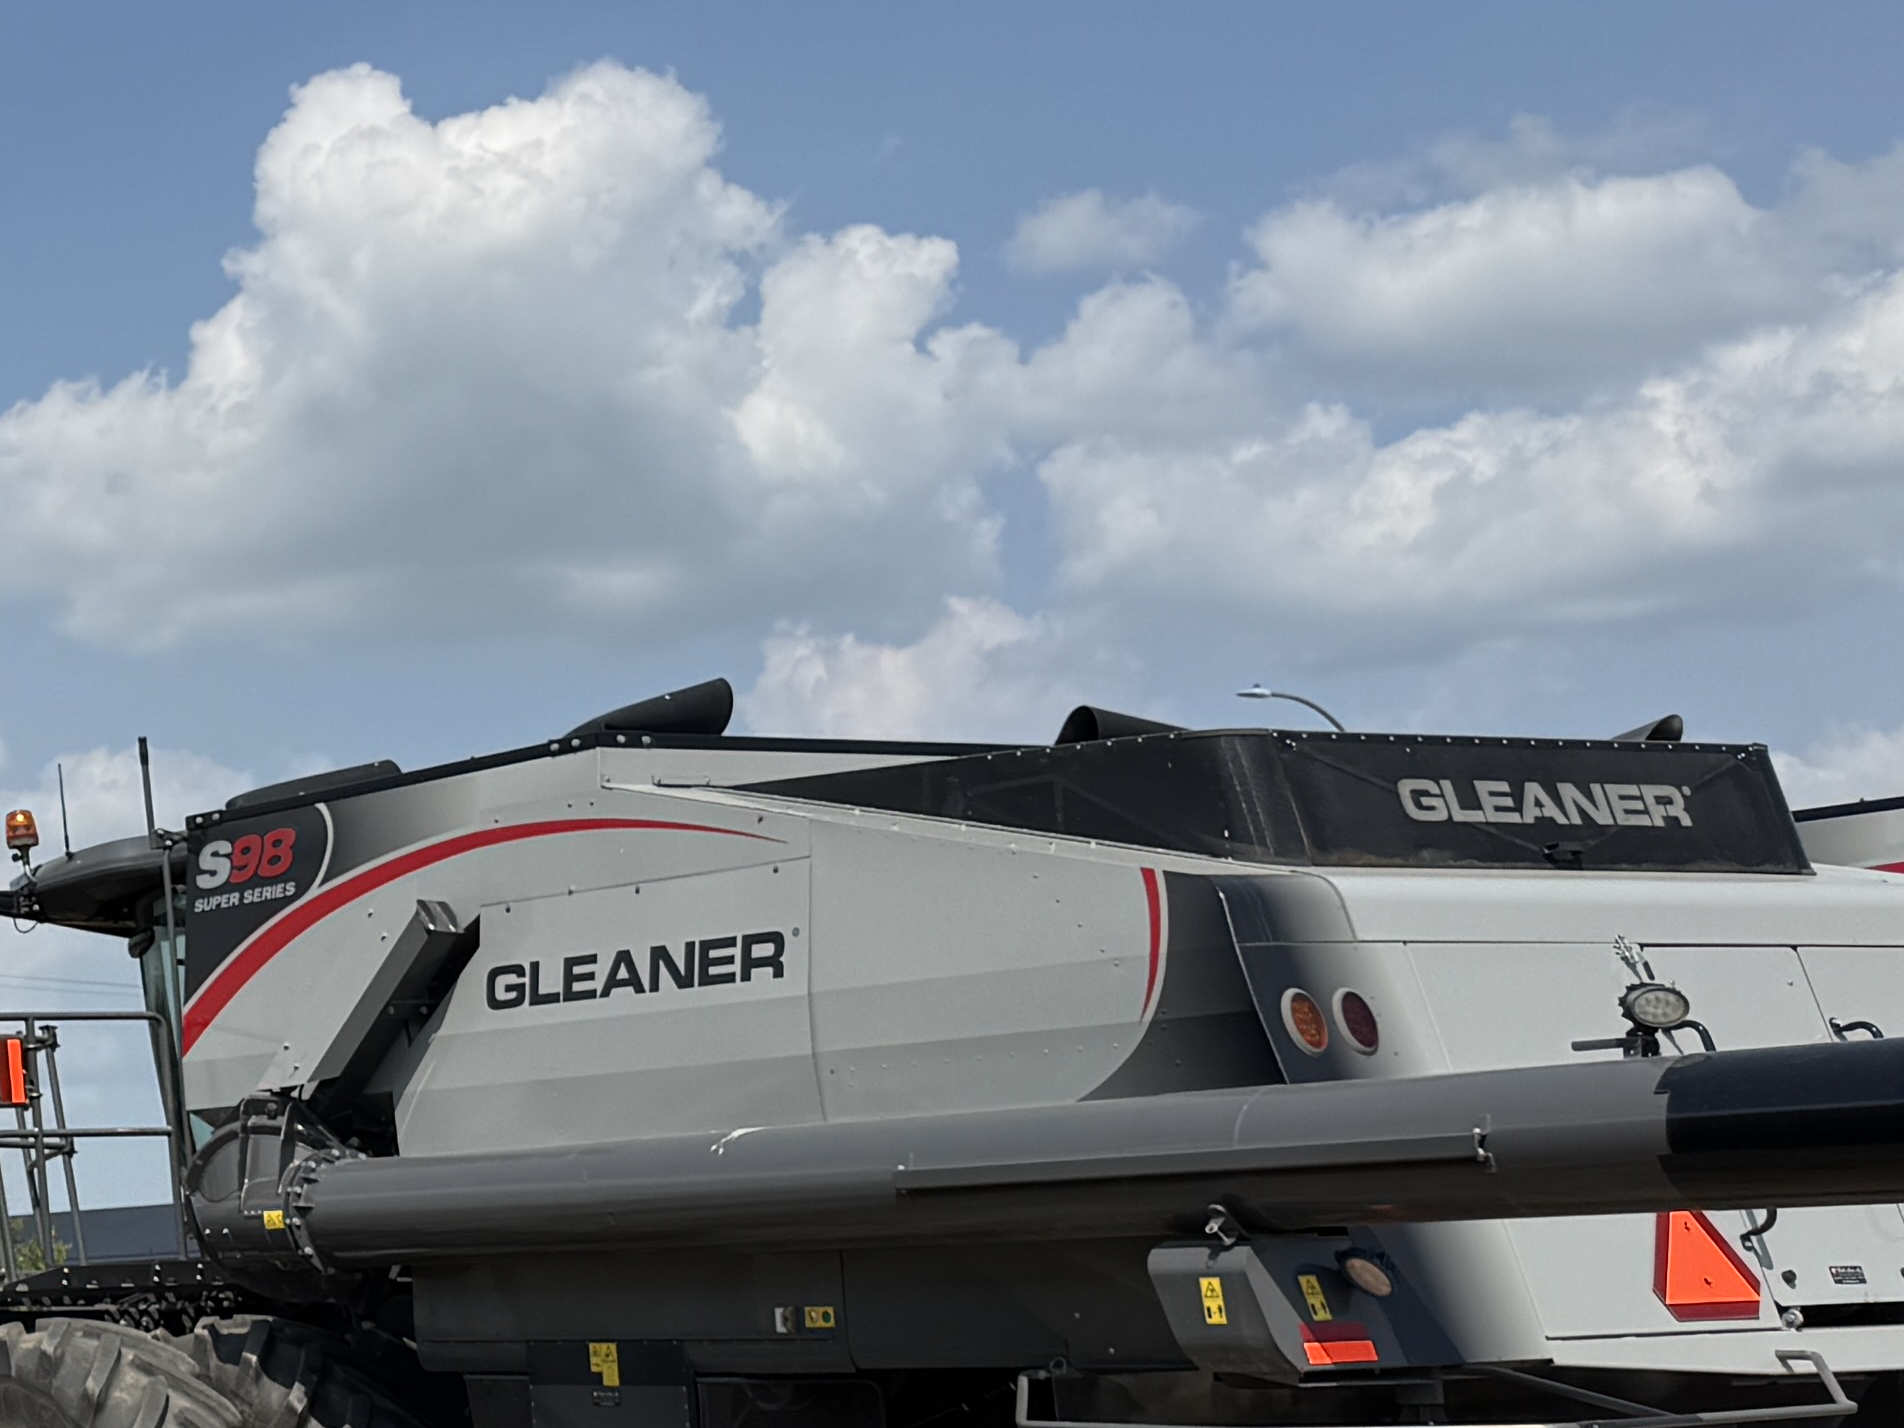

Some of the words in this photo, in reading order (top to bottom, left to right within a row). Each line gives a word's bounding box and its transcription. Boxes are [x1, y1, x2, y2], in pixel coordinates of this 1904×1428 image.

[1397, 778, 1692, 827] GLEANER
[195, 827, 296, 890] S98
[194, 892, 240, 913] SUPER
[243, 882, 296, 904] SERIES
[486, 930, 785, 1010] GLEANER
